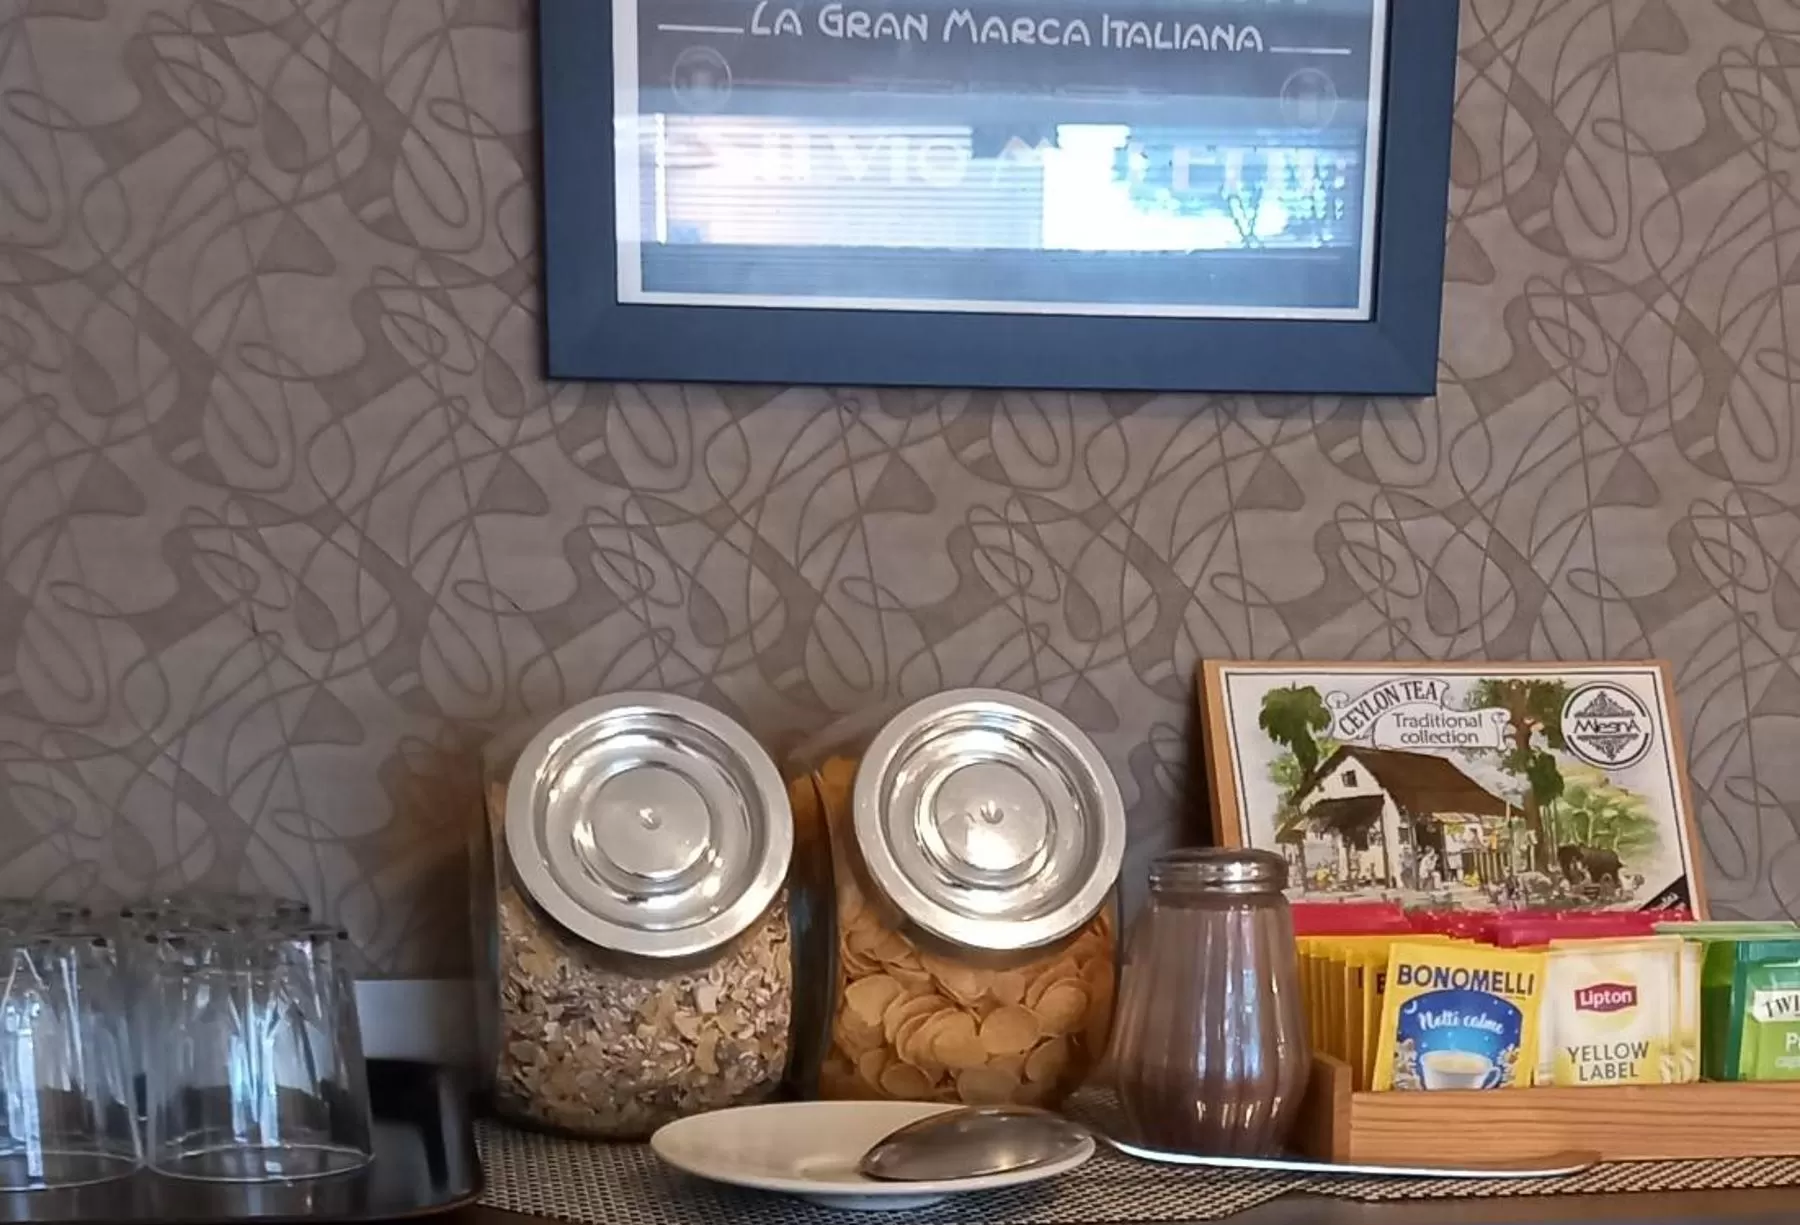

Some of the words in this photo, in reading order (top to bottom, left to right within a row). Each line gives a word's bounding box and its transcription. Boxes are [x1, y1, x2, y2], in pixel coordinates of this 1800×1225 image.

[818, 3, 929, 42] GRAN
[943, 8, 1092, 47] MARCA
[1101, 13, 1264, 53] ITALIANA
[1338, 684, 1401, 736] CEYLON
[1400, 680, 1438, 701] TEA
[1392, 712, 1483, 729] Traditional
[1400, 730, 1480, 744] collection
[1396, 963, 1535, 996] BONOMELLI
[1579, 990, 1633, 1009] Lipton
[1566, 1040, 1651, 1064] YELLOW
[1578, 1062, 1640, 1082] LABEL
